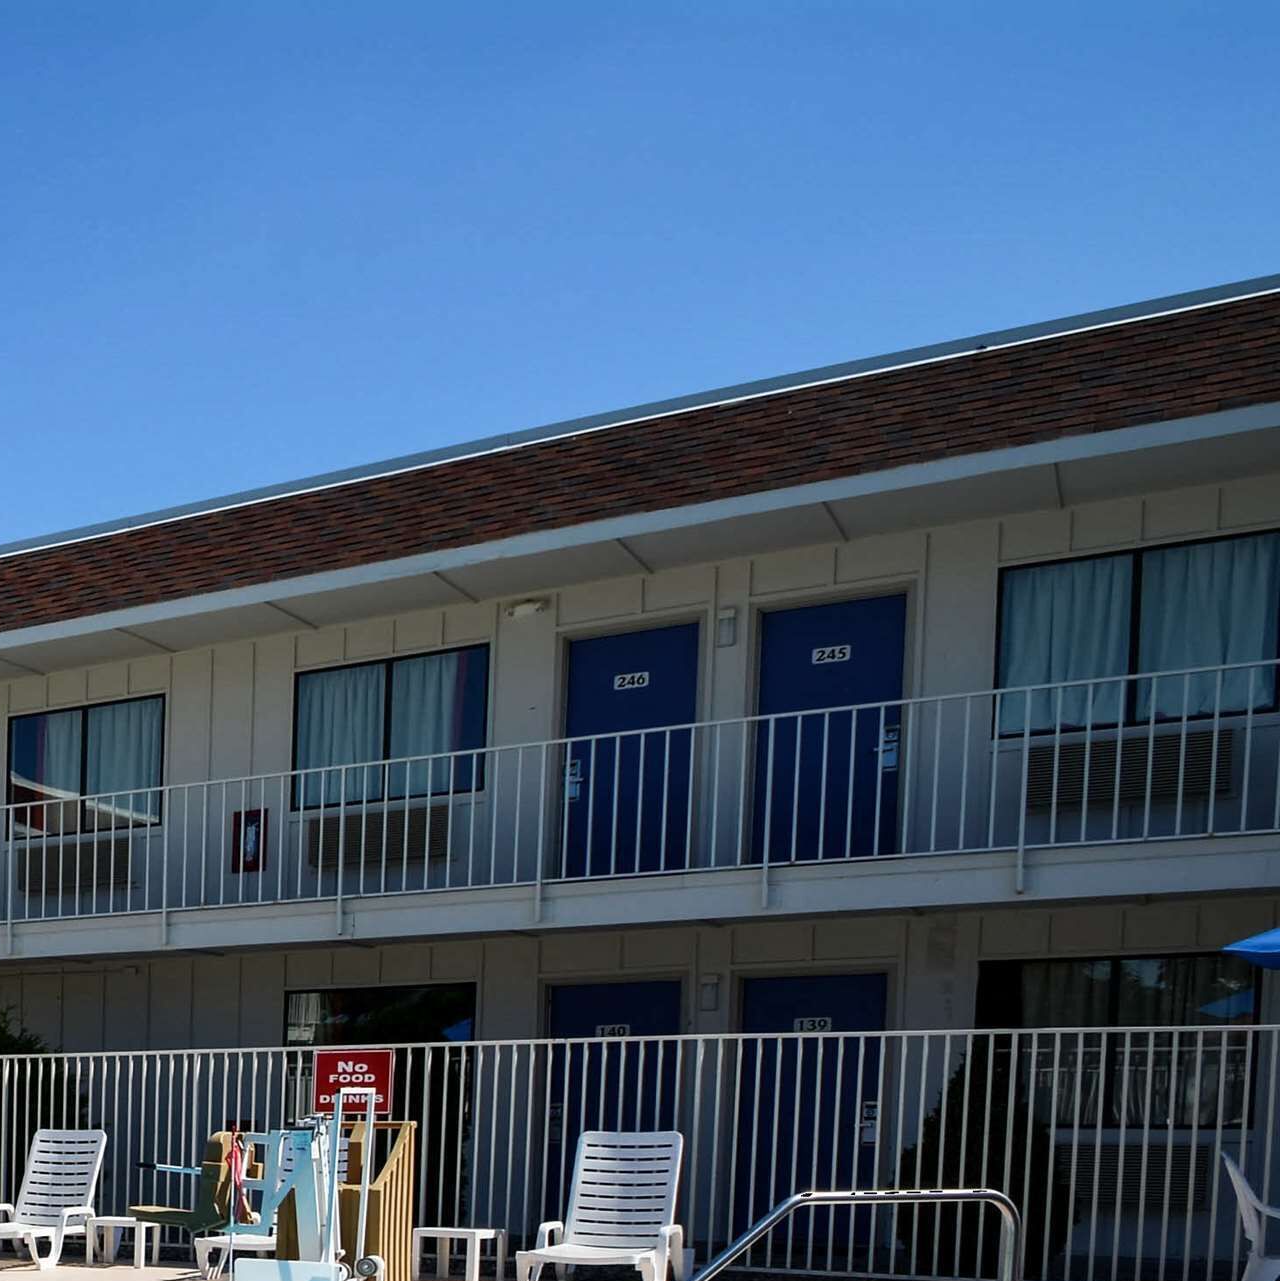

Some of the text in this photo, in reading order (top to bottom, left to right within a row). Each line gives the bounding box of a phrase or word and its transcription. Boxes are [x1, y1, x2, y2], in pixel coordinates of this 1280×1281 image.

[815, 646, 848, 662] 245
[616, 674, 646, 689] 246
[798, 1018, 829, 1032] 139
[337, 1060, 368, 1073] No
[328, 1074, 376, 1083] FOOD
